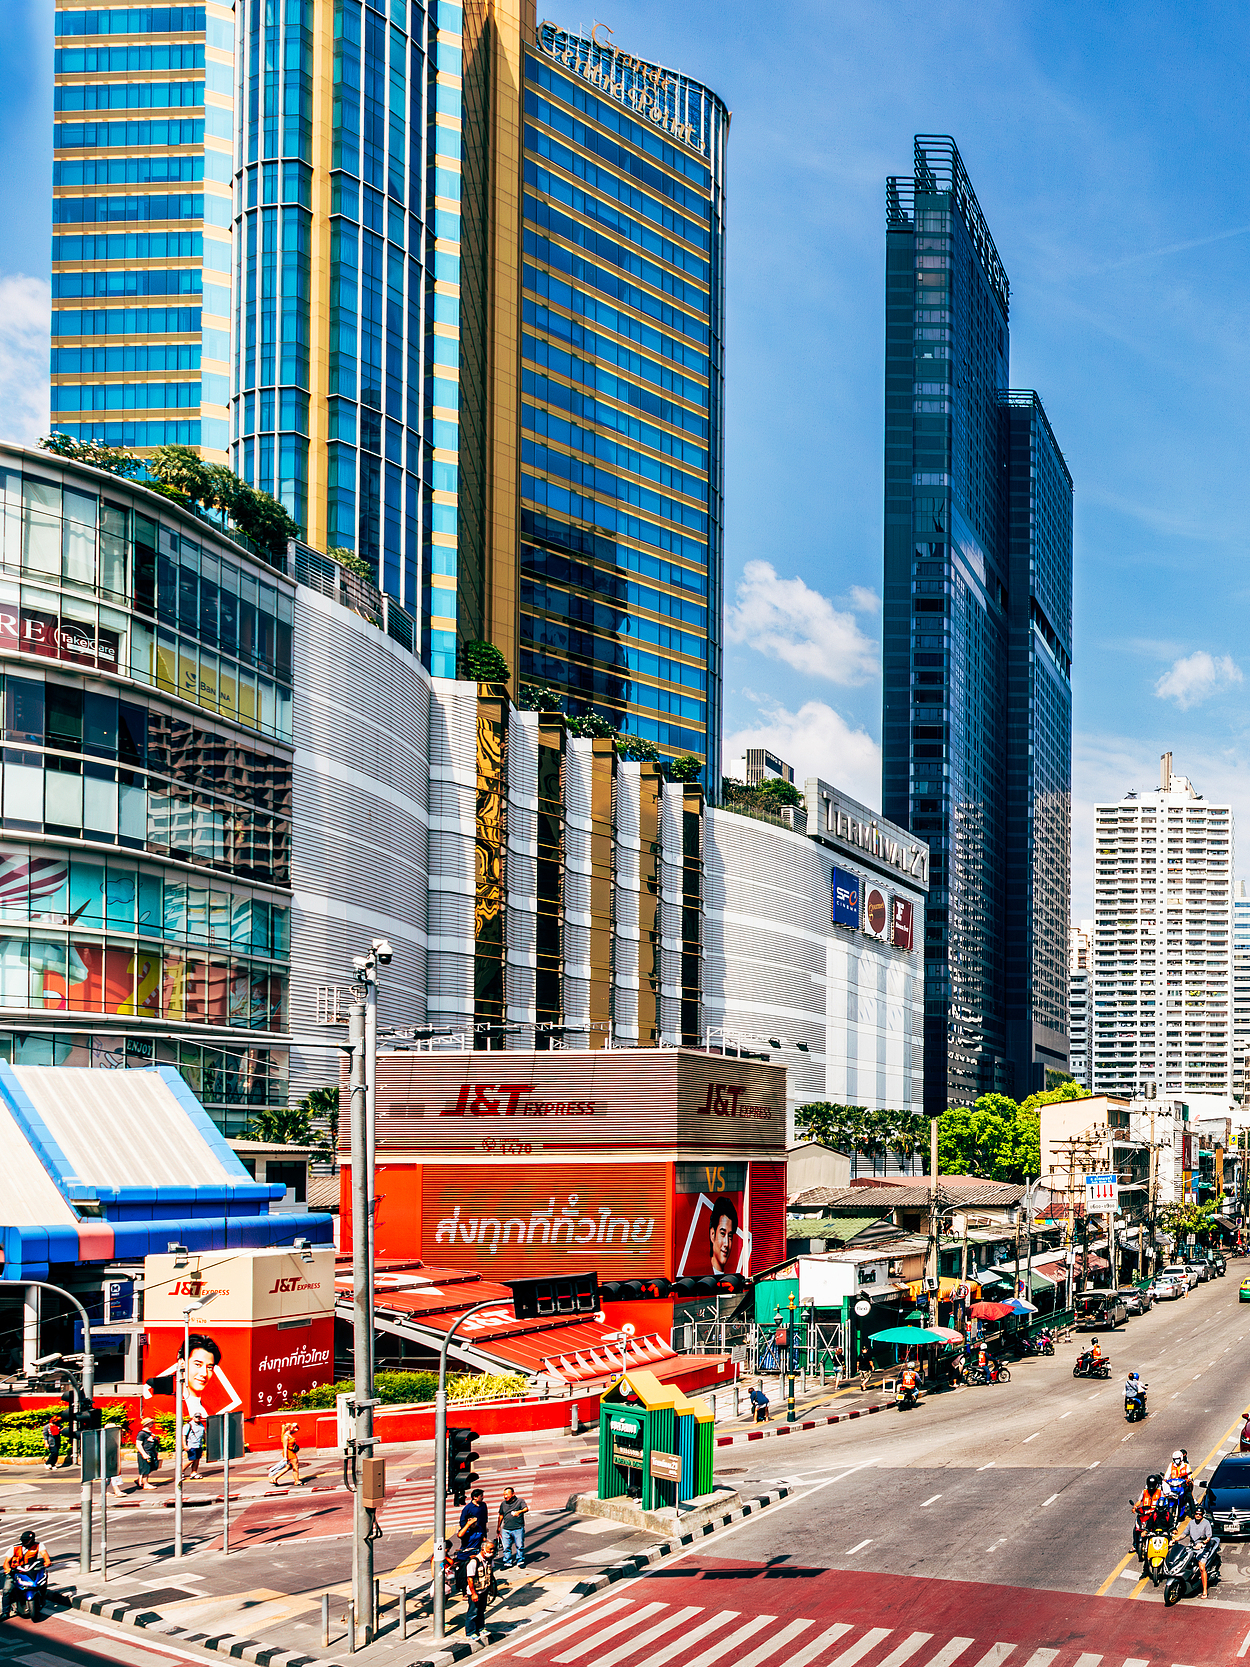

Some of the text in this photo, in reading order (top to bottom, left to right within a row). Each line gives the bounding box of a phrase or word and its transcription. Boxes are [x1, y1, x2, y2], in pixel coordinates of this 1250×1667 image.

[537, 20, 706, 151] Centre Point
[60, 631, 88, 647] Take
[127, 1040, 153, 1056] ENJOY
[439, 1083, 596, 1117] J&T EXPRESS
[697, 1083, 747, 1118] J&T
[435, 1193, 655, 1254] ส่งทุกที่ทั่วไทย
[168, 1281, 208, 1296] J&T
[268, 1277, 321, 1294] J&T EXPRESS
[258, 1344, 330, 1373] ส่งทุกที่ทั่วไทย
